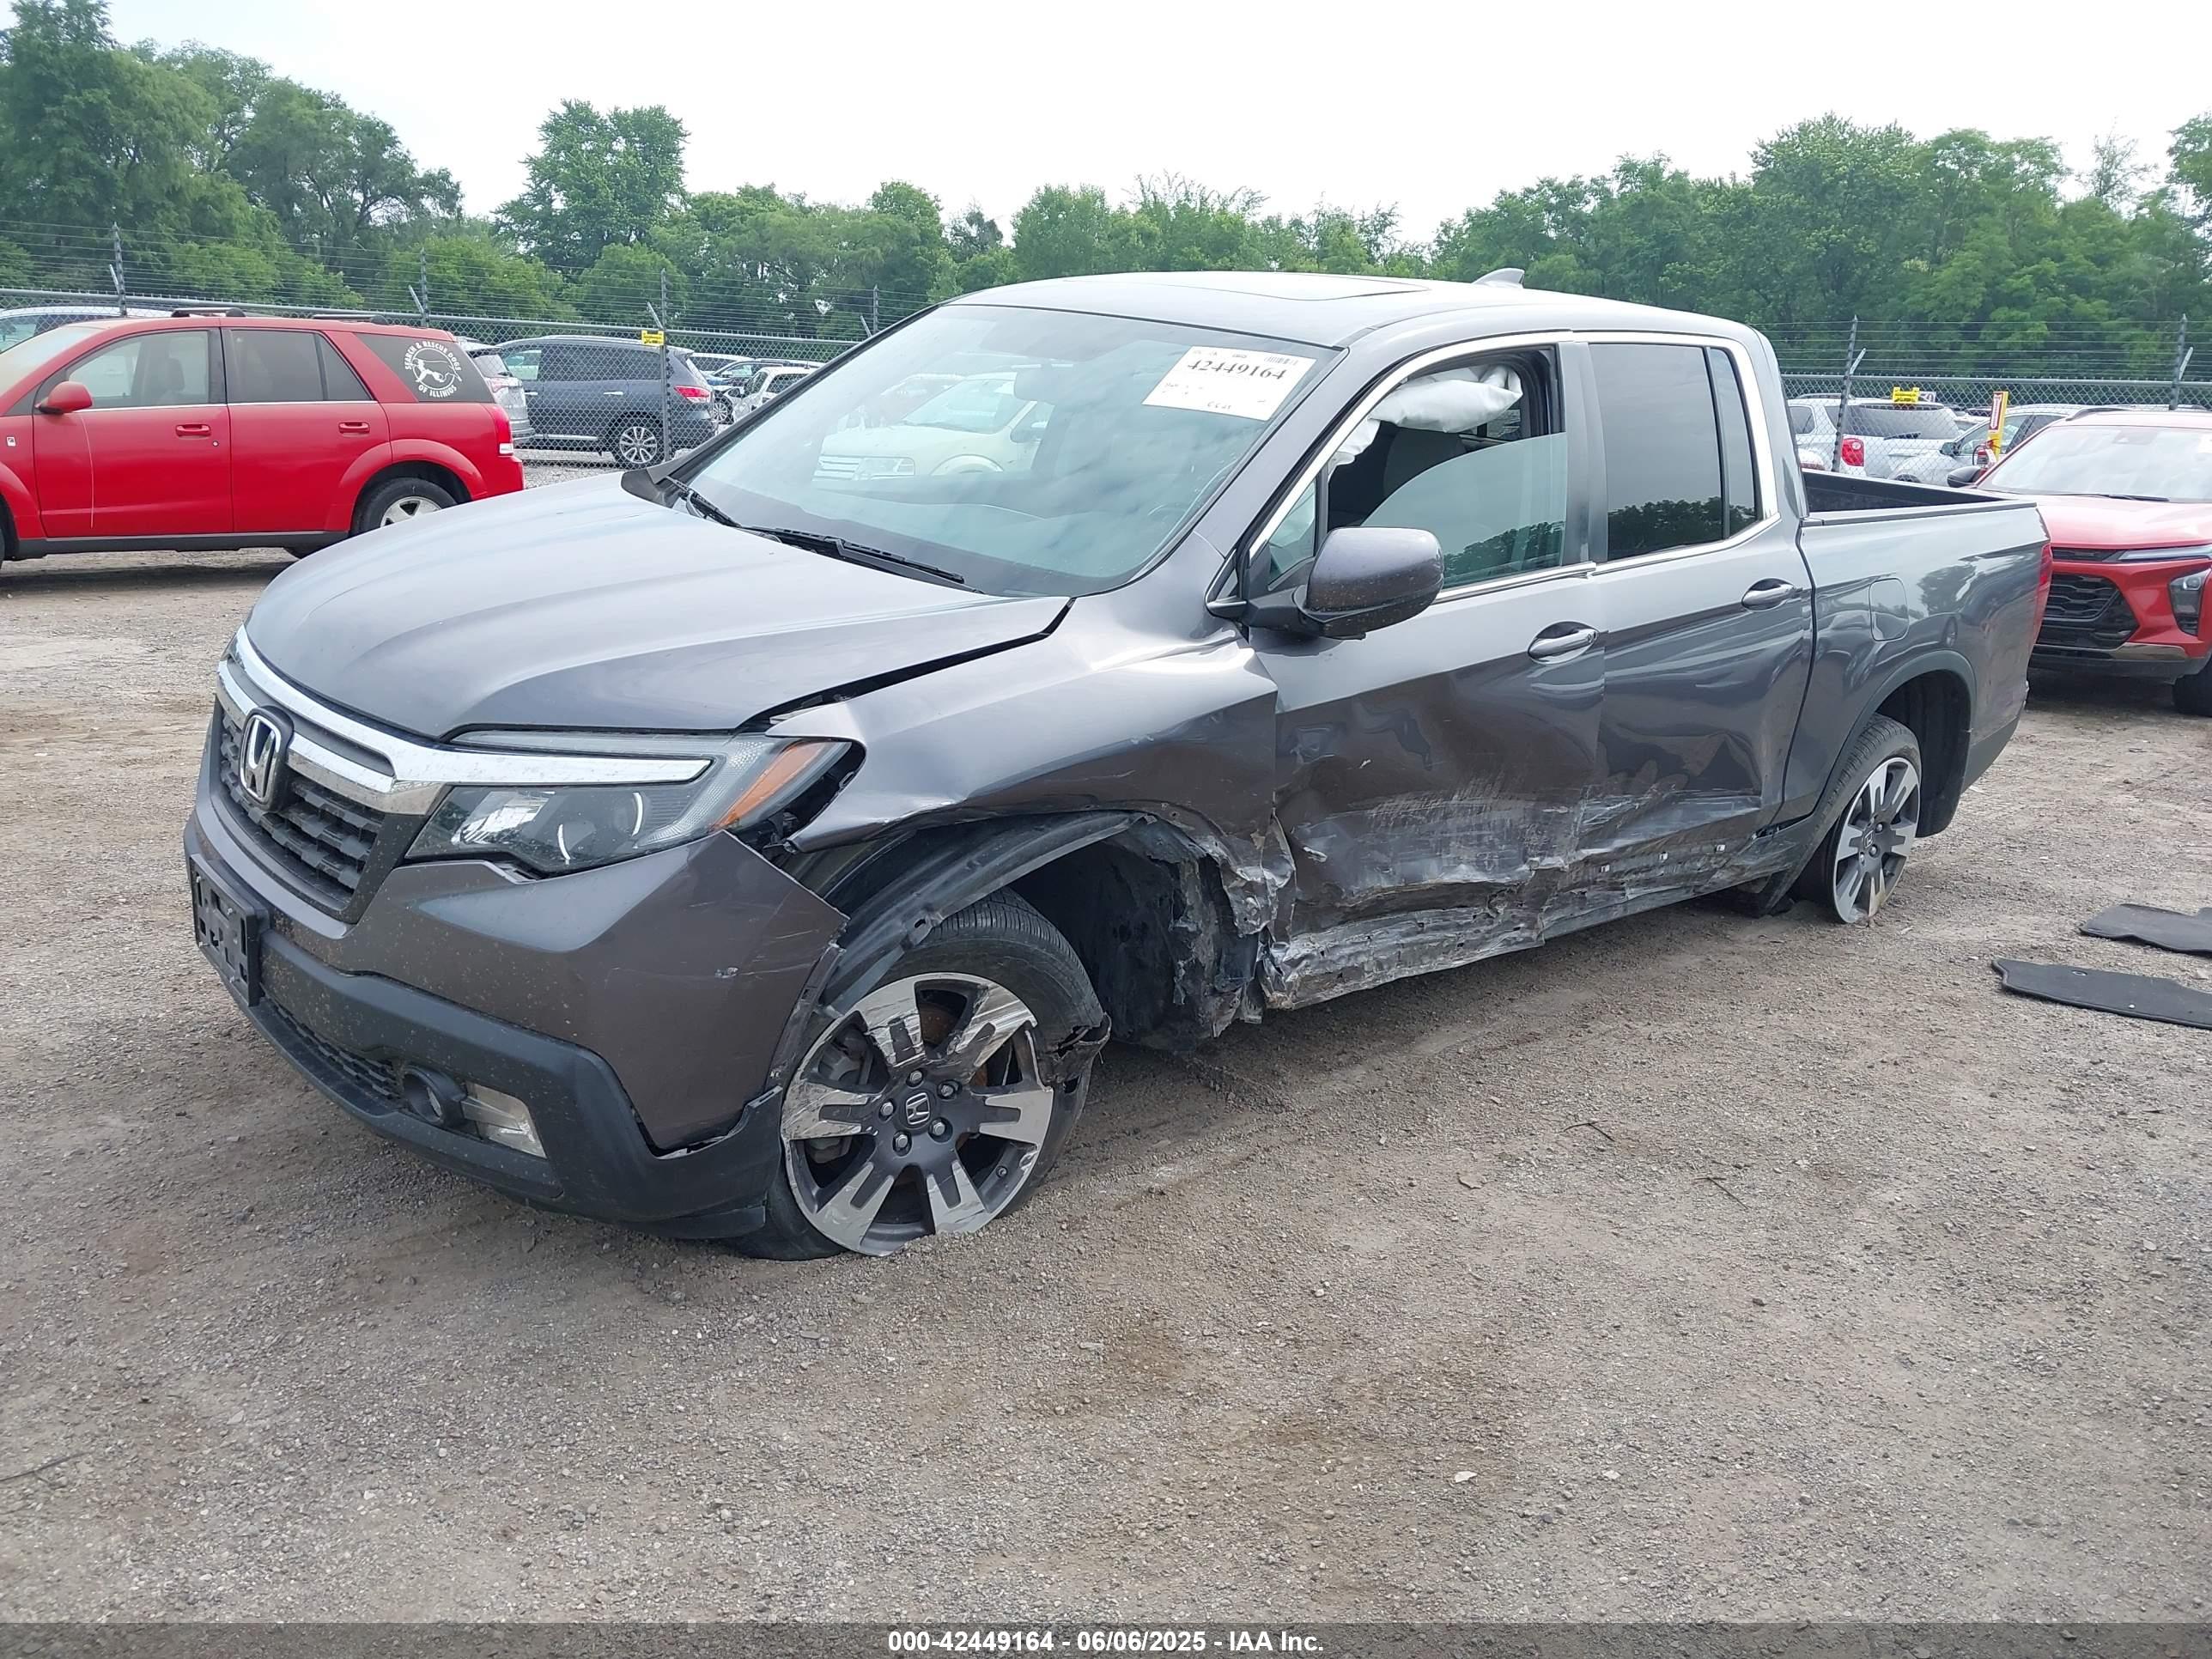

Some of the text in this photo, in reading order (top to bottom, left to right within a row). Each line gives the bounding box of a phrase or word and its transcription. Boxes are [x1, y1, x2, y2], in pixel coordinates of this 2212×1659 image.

[404, 345, 416, 370] SEARCH
[422, 341, 448, 354] RESCUE
[447, 352, 461, 371] DOGS
[1188, 359, 1287, 380] 42449164
[418, 384, 428, 393] OF
